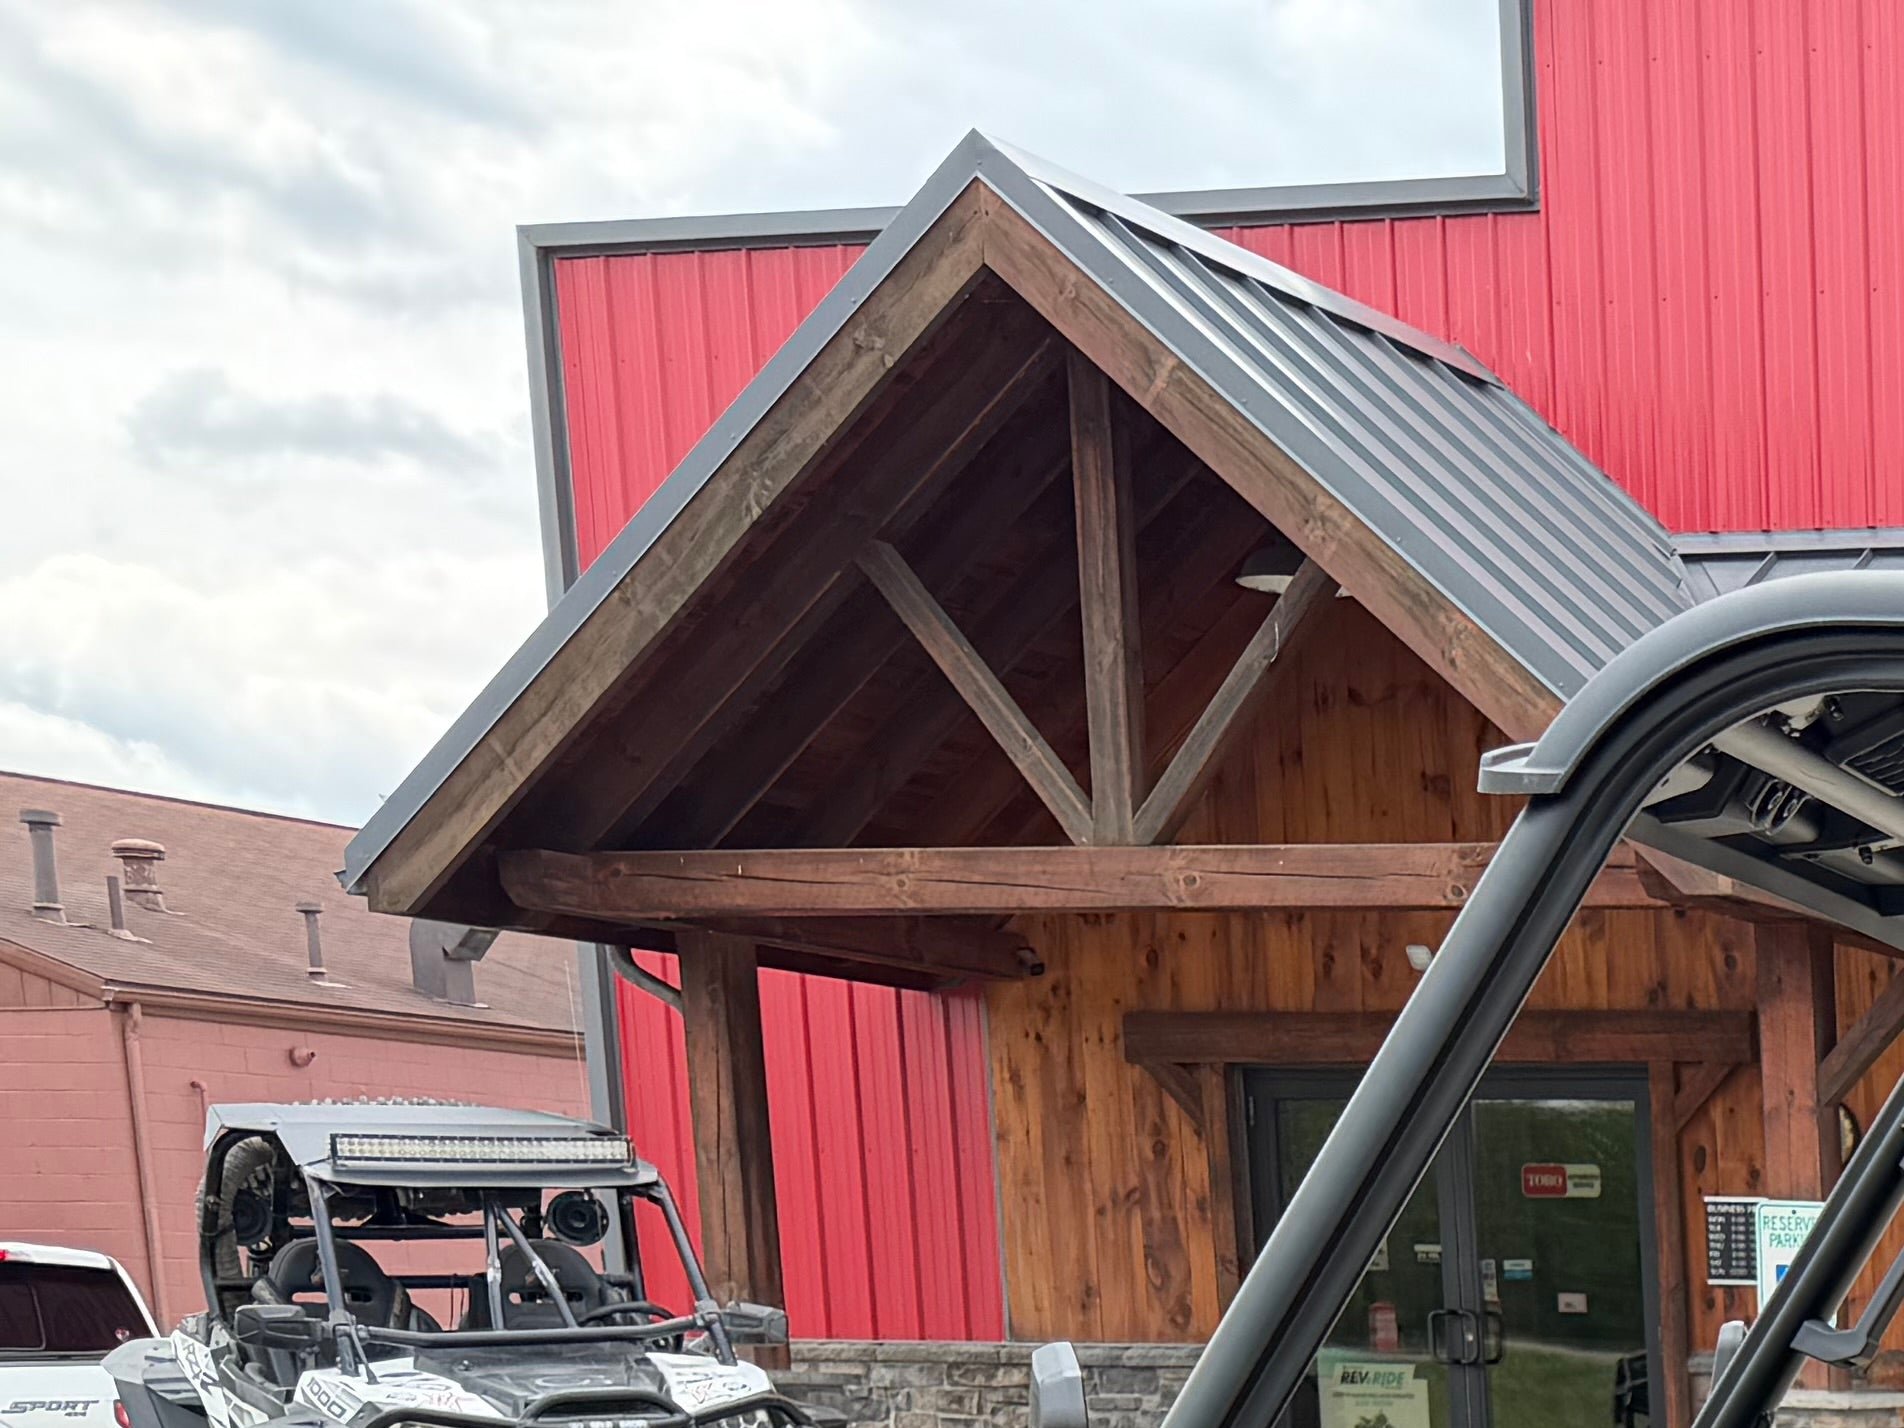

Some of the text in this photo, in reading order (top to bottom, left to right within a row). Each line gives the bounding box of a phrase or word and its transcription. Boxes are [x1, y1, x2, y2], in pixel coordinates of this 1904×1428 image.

[1763, 1215, 1818, 1231] RESERV
[307, 1377, 347, 1419] 1000
[1, 1400, 99, 1414] SPORT
